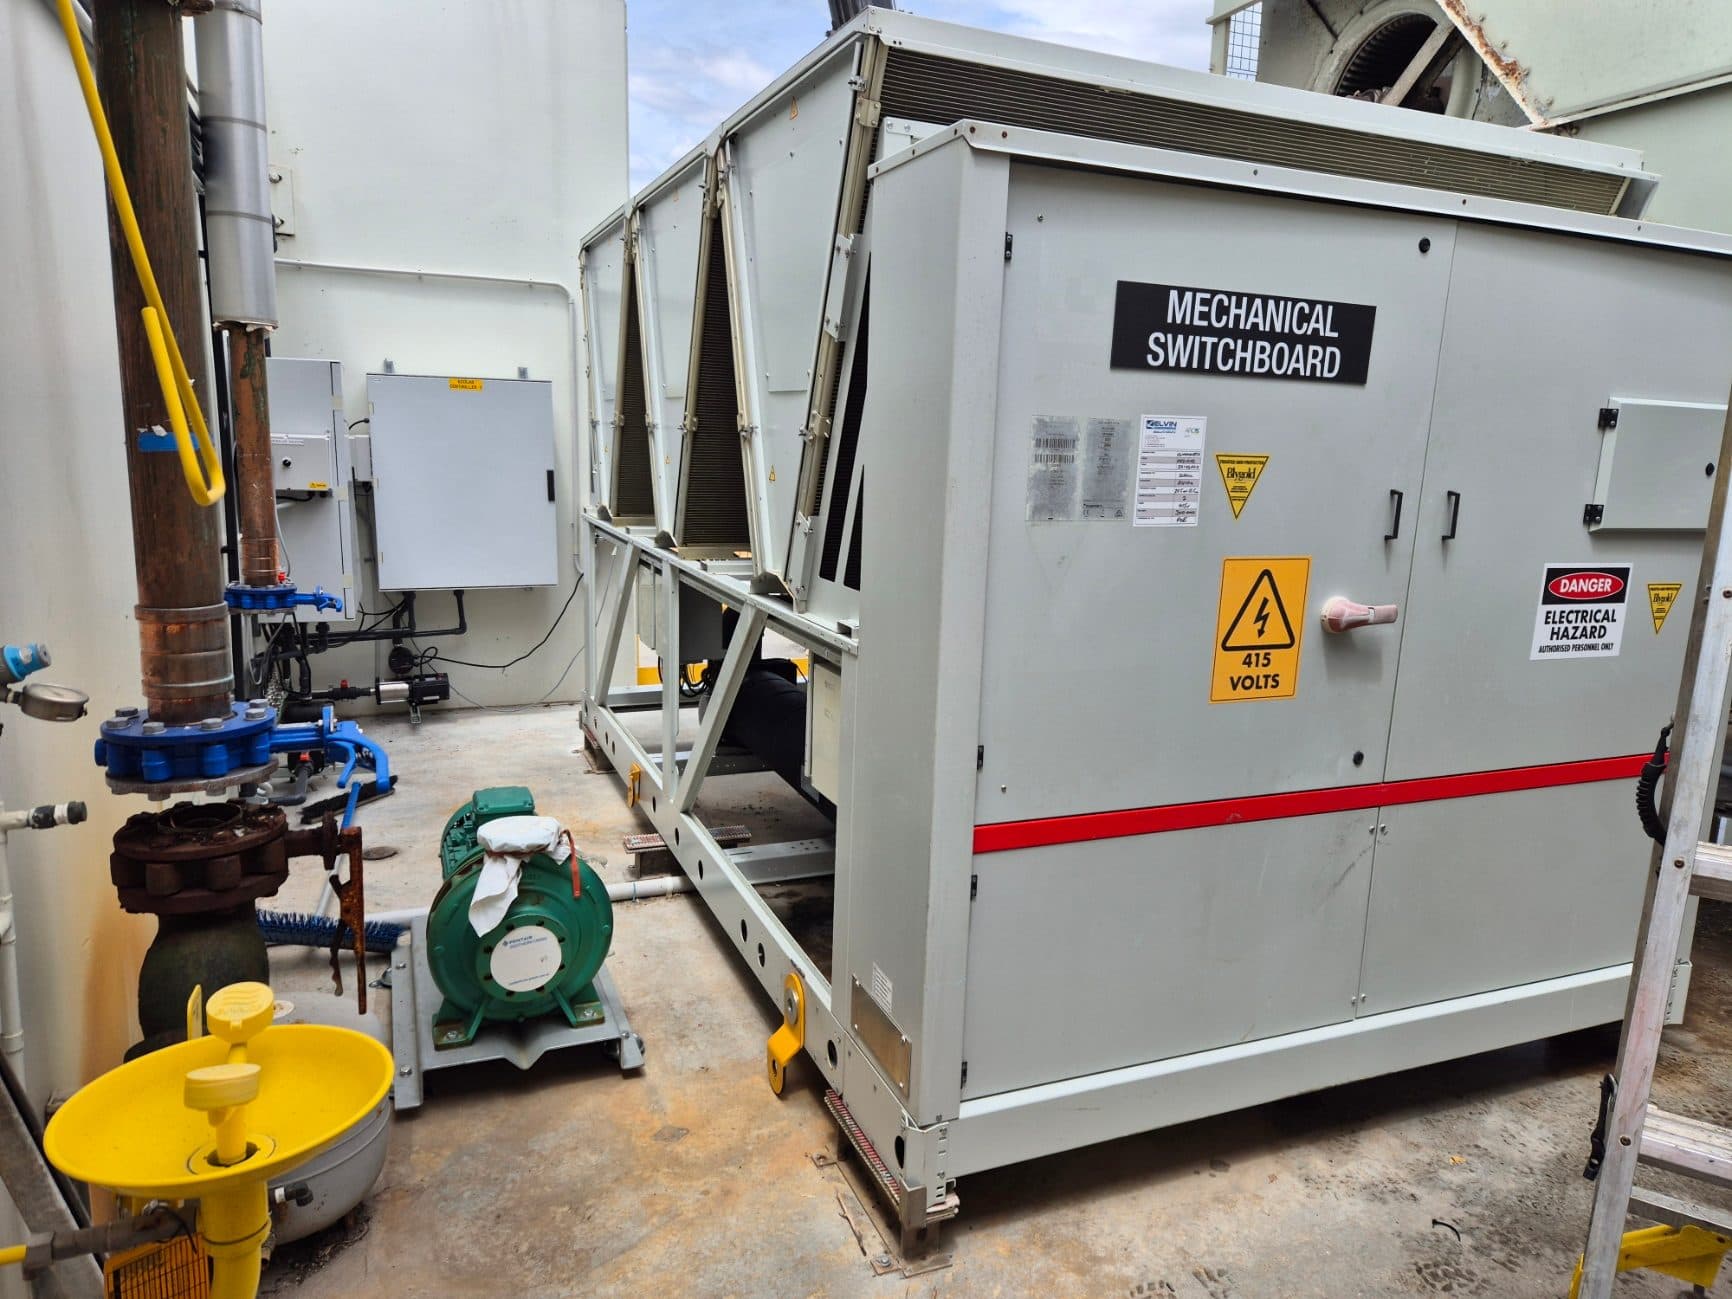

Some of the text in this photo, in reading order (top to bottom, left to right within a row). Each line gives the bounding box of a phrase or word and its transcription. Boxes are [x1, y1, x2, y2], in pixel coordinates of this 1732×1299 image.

[1166, 289, 1339, 338] MECHANICAL
[1146, 331, 1342, 379] SWITCHBOARD
[1226, 466, 1256, 481] Blygold
[1560, 578, 1612, 593] DANGER
[1544, 608, 1617, 625] ELECTRICAL
[1550, 625, 1607, 641] HAZARD
[1538, 642, 1614, 654] AUTHORISED PERSONNEL ONLY
[1242, 651, 1272, 668] 415
[1229, 673, 1280, 692] VOLTS
